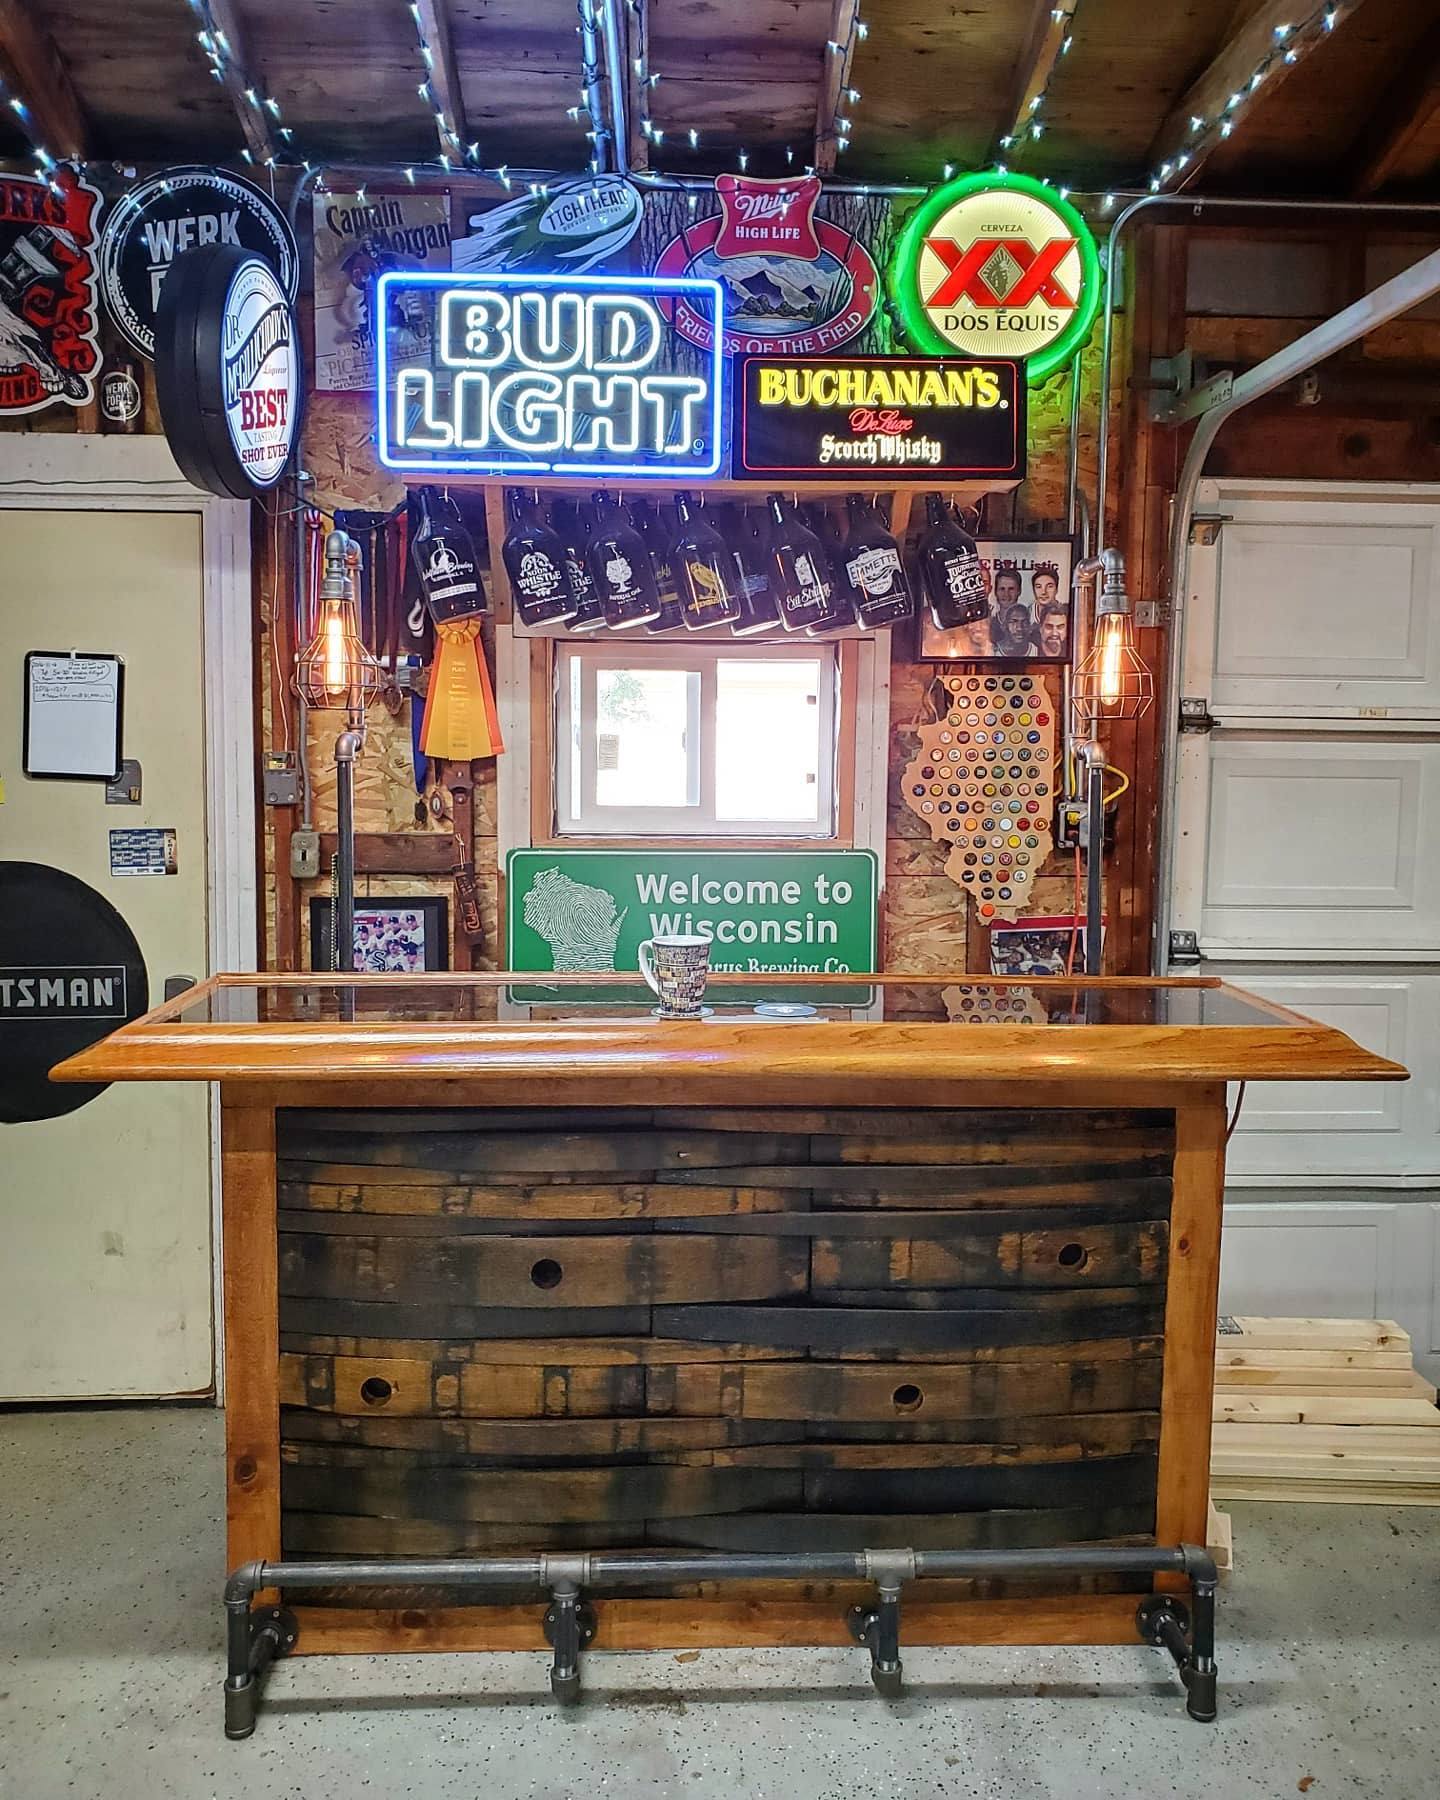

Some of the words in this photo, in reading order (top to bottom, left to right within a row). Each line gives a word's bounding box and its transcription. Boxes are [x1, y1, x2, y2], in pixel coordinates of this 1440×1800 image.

[326, 197, 404, 240] Captain
[546, 187, 629, 231] TIGHTHEAD
[735, 192, 801, 220] Miller
[144, 210, 242, 263] WERK
[370, 222, 450, 260] Morgan
[735, 225, 769, 239] HIGH
[771, 226, 801, 240] LIFE
[980, 224, 1023, 232] CERVEZA
[922, 237, 1080, 309] XX
[441, 290, 660, 369] BUD
[777, 338, 816, 353] THE
[816, 311, 863, 347] FIELD
[944, 314, 989, 331] DOS
[996, 314, 1060, 332] EQUIS
[239, 388, 288, 431] BEST
[396, 367, 707, 452] LIGHT
[242, 447, 266, 464] SHOT
[267, 443, 289, 460] EVER
[819, 435, 875, 464] Scotch
[875, 436, 943, 464] Whisky
[518, 570, 562, 588] WHISTLE
[635, 873, 801, 904] Welcome
[814, 873, 852, 905] to
[649, 912, 839, 943] Wisconsin
